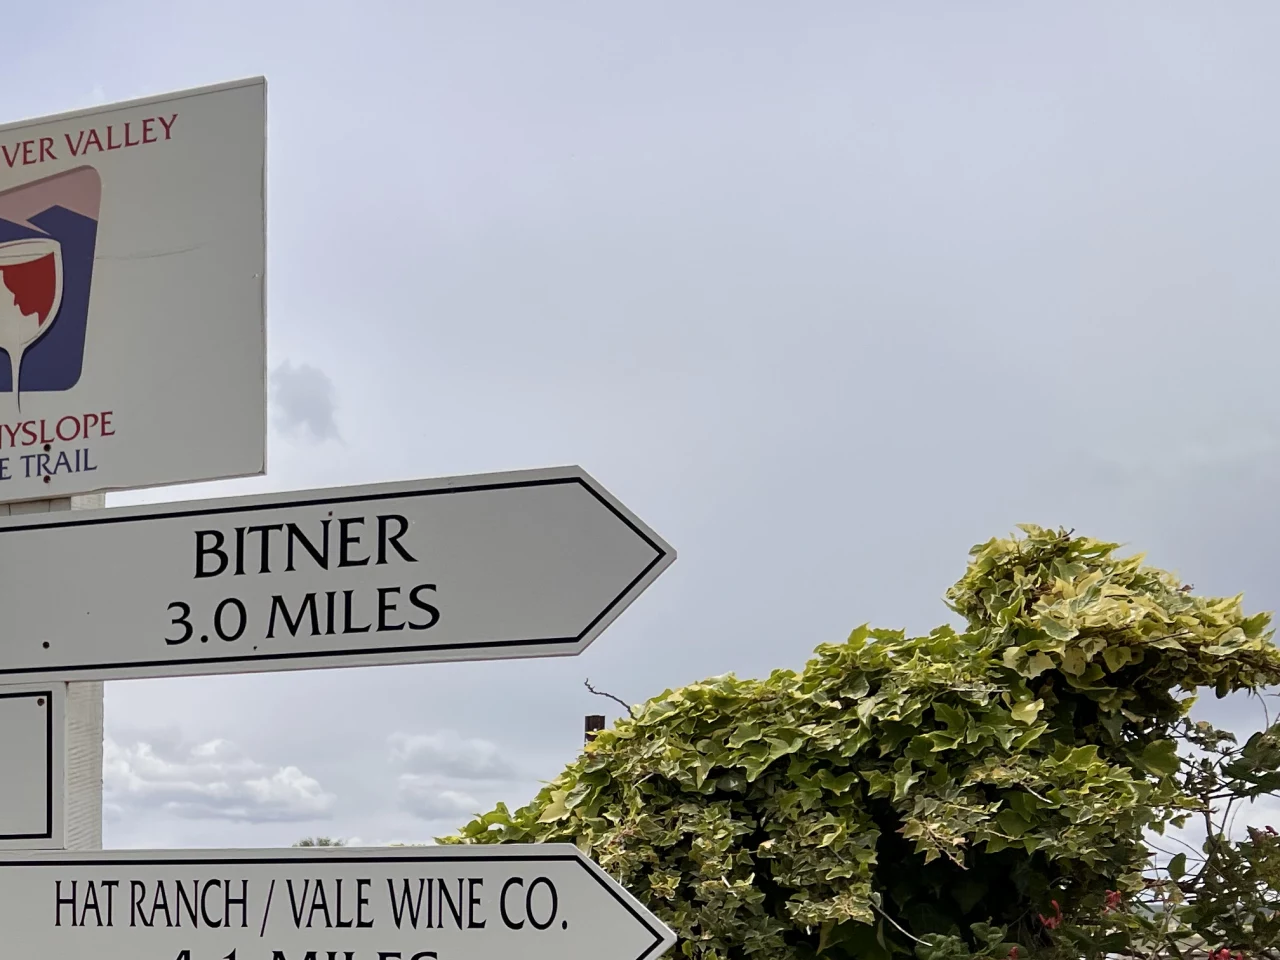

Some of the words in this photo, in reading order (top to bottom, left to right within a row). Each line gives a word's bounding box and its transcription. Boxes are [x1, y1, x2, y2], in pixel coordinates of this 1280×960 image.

[64, 113, 179, 157] VALLEY
[20, 448, 98, 478] TRAIL
[193, 513, 419, 580] BITNER
[164, 597, 248, 646] 3.0
[265, 583, 441, 640] MILES
[54, 879, 120, 928] HAT
[129, 879, 249, 930] RANCH
[259, 878, 276, 938] /
[285, 878, 375, 930] VALE
[385, 877, 488, 931] WINE
[499, 876, 569, 931] CO.
